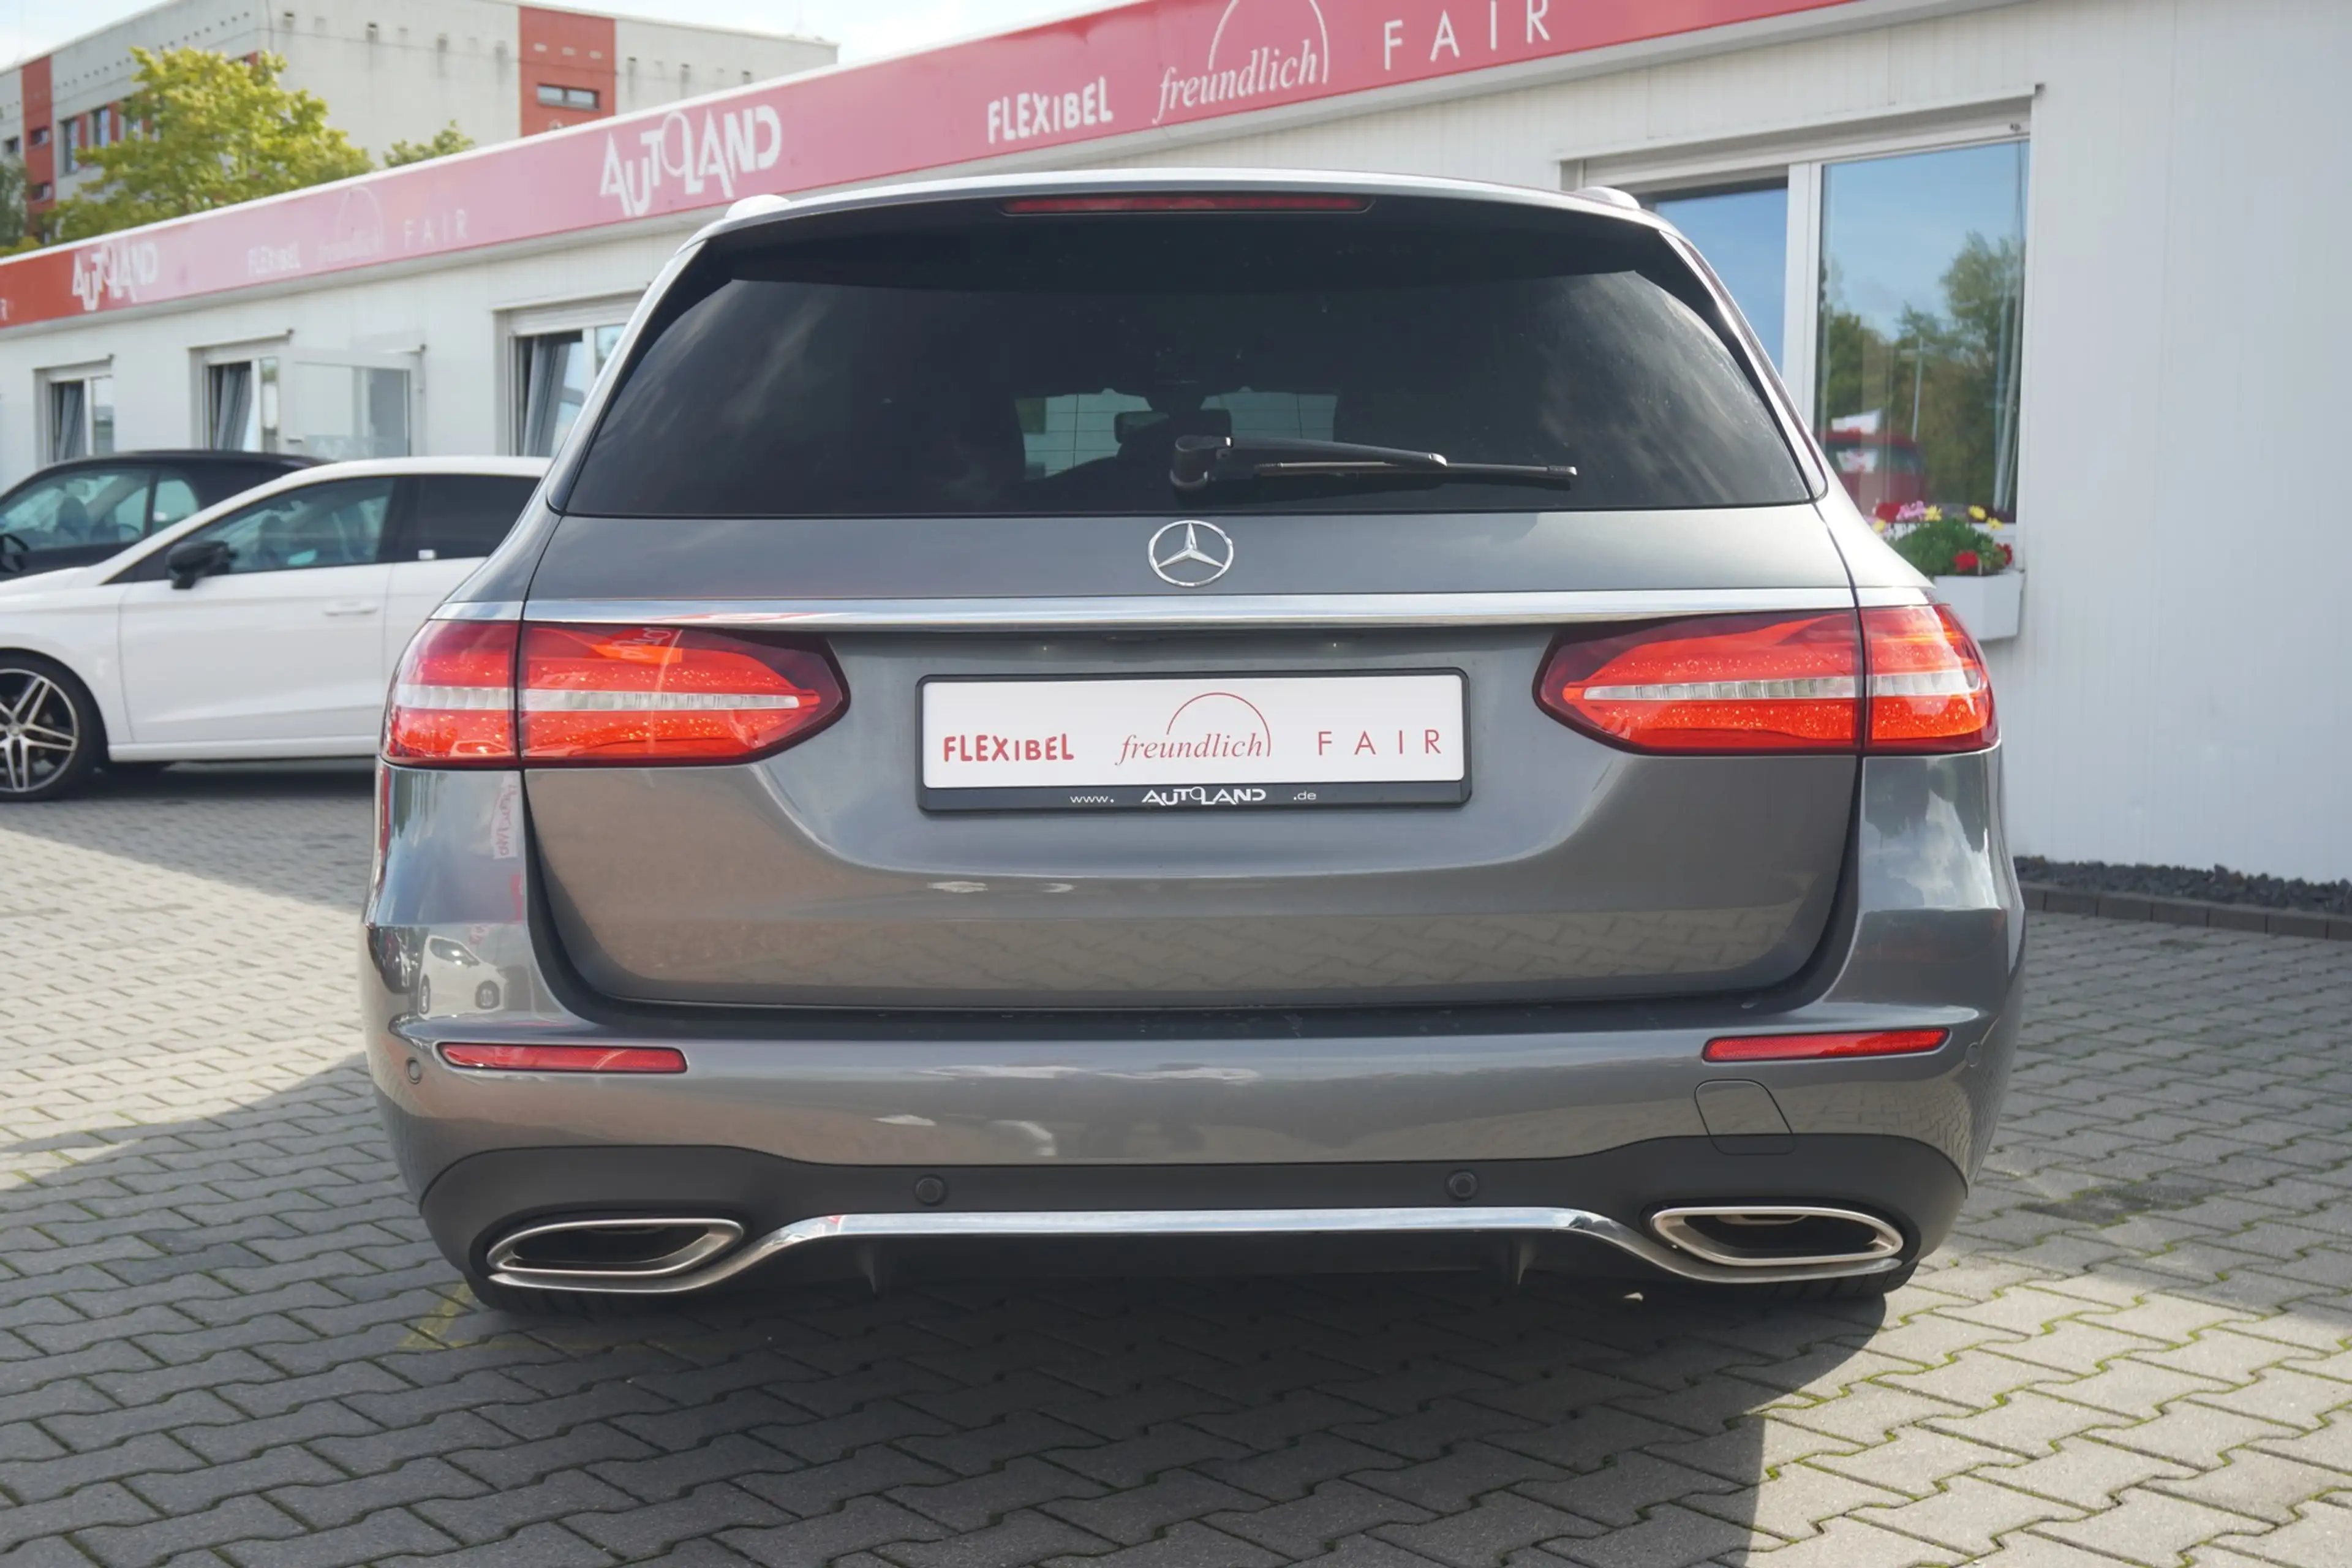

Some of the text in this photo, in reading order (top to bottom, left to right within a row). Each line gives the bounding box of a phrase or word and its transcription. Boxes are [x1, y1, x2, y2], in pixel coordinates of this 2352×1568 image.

[987, 0, 1551, 145] FLEXIBEL freundlich FAIR
[599, 104, 782, 217] AUTOLAND
[404, 208, 468, 249] FAIR
[944, 728, 1442, 766] FLEXIBEL freundlich FAIR
[1069, 786, 1317, 806] www. AUTOLAND .de
